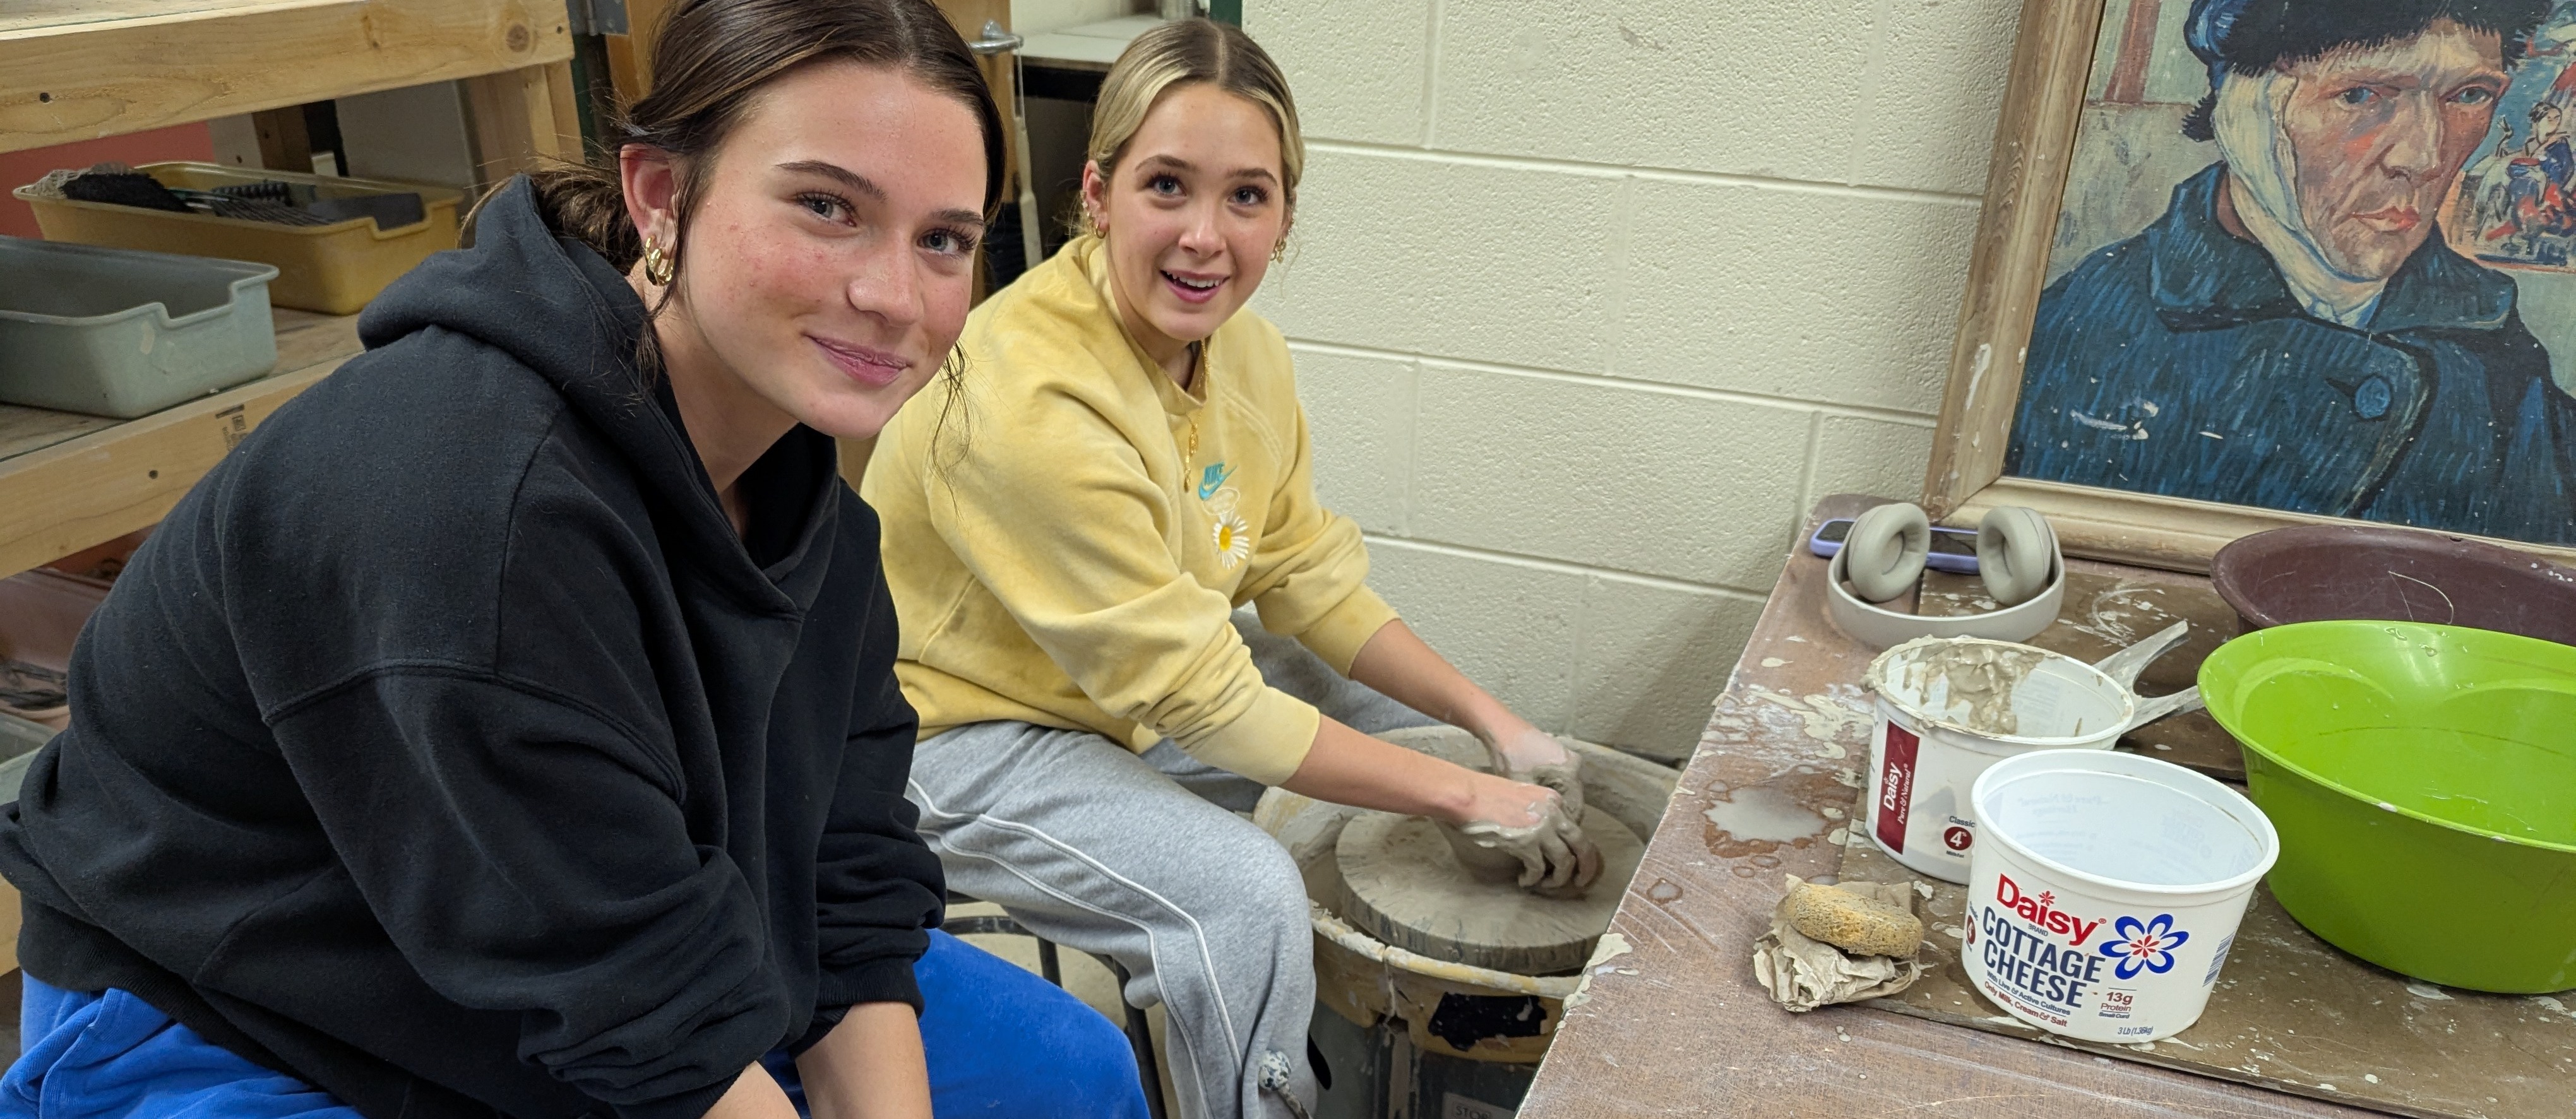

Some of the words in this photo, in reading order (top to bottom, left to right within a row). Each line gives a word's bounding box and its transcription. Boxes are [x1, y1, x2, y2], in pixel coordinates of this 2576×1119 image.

[1883, 762, 1902, 811] Daisy
[1900, 797, 1906, 807] &
[1897, 806, 1905, 824] Pure
[1949, 815, 1976, 827] Classic
[2028, 923, 2049, 937] BRAND
[1983, 906, 2106, 983] COTTAGE
[1984, 938, 2087, 1009] CHEESE
[1986, 970, 1998, 982] With
[1998, 977, 2010, 991] Live
[2011, 987, 2018, 995] &
[2018, 990, 2039, 1005] Active
[2041, 1000, 2071, 1015] Cultures
[2106, 992, 2133, 1005] 13g
[1984, 981, 1998, 996] Only
[2015, 1000, 2039, 1017] Cream
[2039, 1010, 2050, 1021] &
[2051, 1017, 2068, 1027] Salt
[2101, 1003, 2132, 1012] Protein
[2123, 1027, 2131, 1035] Lb
